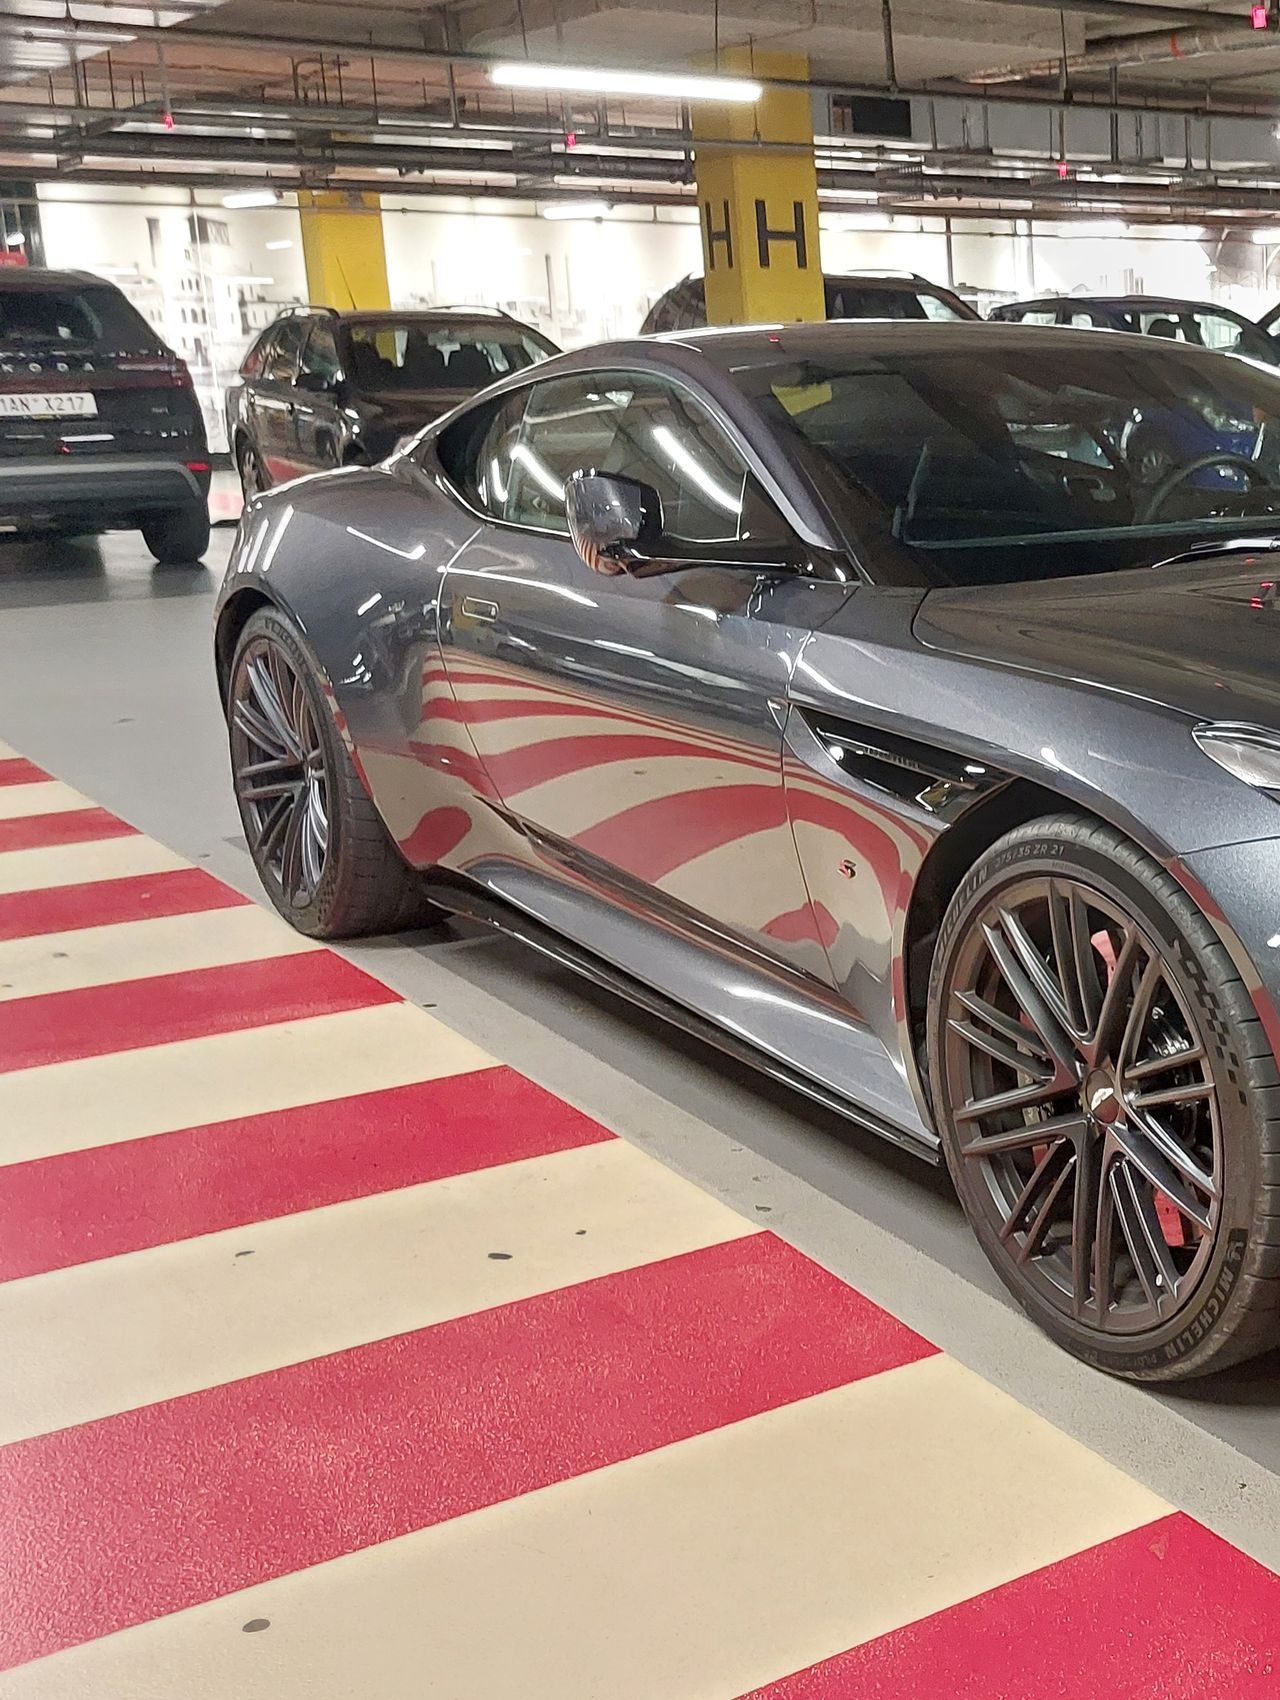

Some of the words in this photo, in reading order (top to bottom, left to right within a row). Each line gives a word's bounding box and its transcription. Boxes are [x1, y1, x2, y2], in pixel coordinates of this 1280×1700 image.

[705, 201, 733, 269] H
[755, 200, 807, 269] H
[42, 395, 85, 412] X217
[1033, 843, 1048, 856] ZR
[1050, 844, 1065, 856] 21
[1165, 1265, 1235, 1359] MICHELIN
